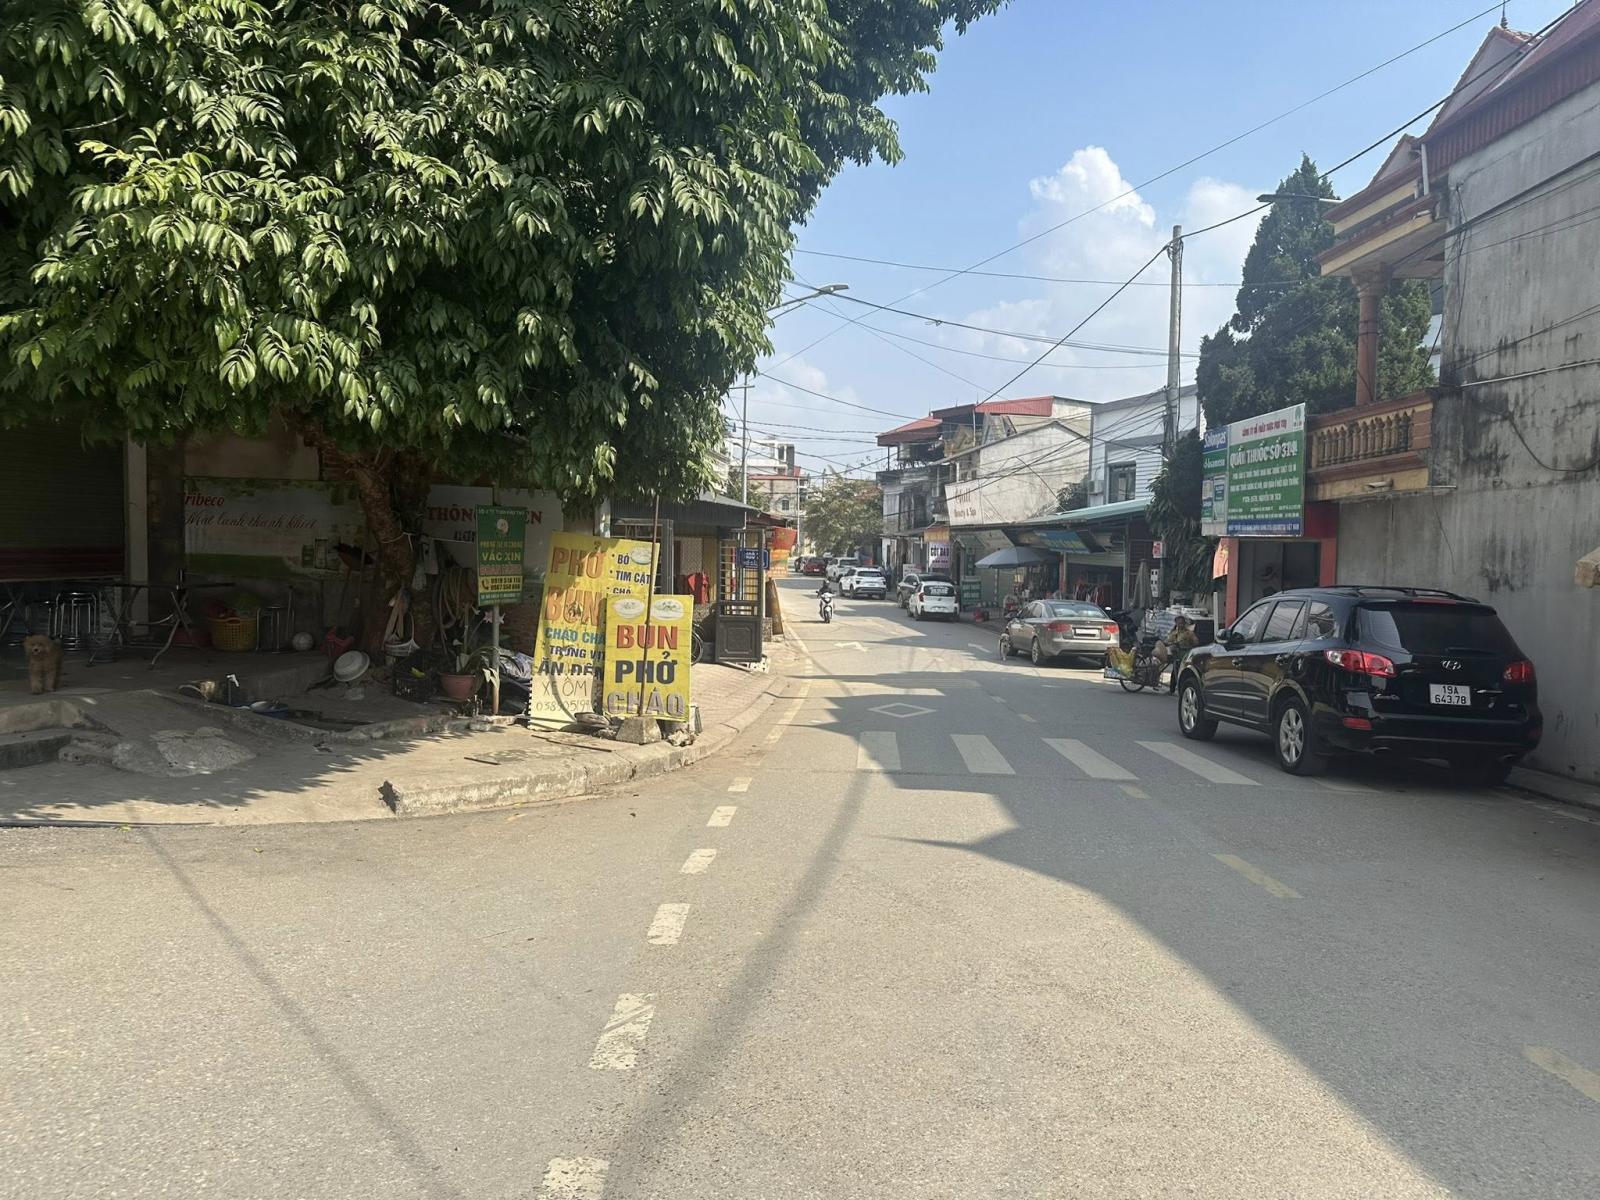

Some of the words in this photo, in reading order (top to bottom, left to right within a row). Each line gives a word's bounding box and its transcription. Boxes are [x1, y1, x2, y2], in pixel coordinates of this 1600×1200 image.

[1246, 441, 1270, 464] THUỐC
[426, 504, 477, 522] THÔN
[504, 551, 521, 561] XIN
[551, 541, 607, 579] PHỞ
[616, 570, 632, 583] TIM
[544, 627, 578, 642] CHÁO
[617, 621, 678, 649] BÚN
[538, 657, 564, 676] ĂN
[615, 651, 678, 684] PHỞ
[562, 676, 588, 697] ÔM
[1442, 686, 1459, 695] 19A
[607, 687, 685, 717] CHÁO
[1435, 695, 1467, 705] 643.78
